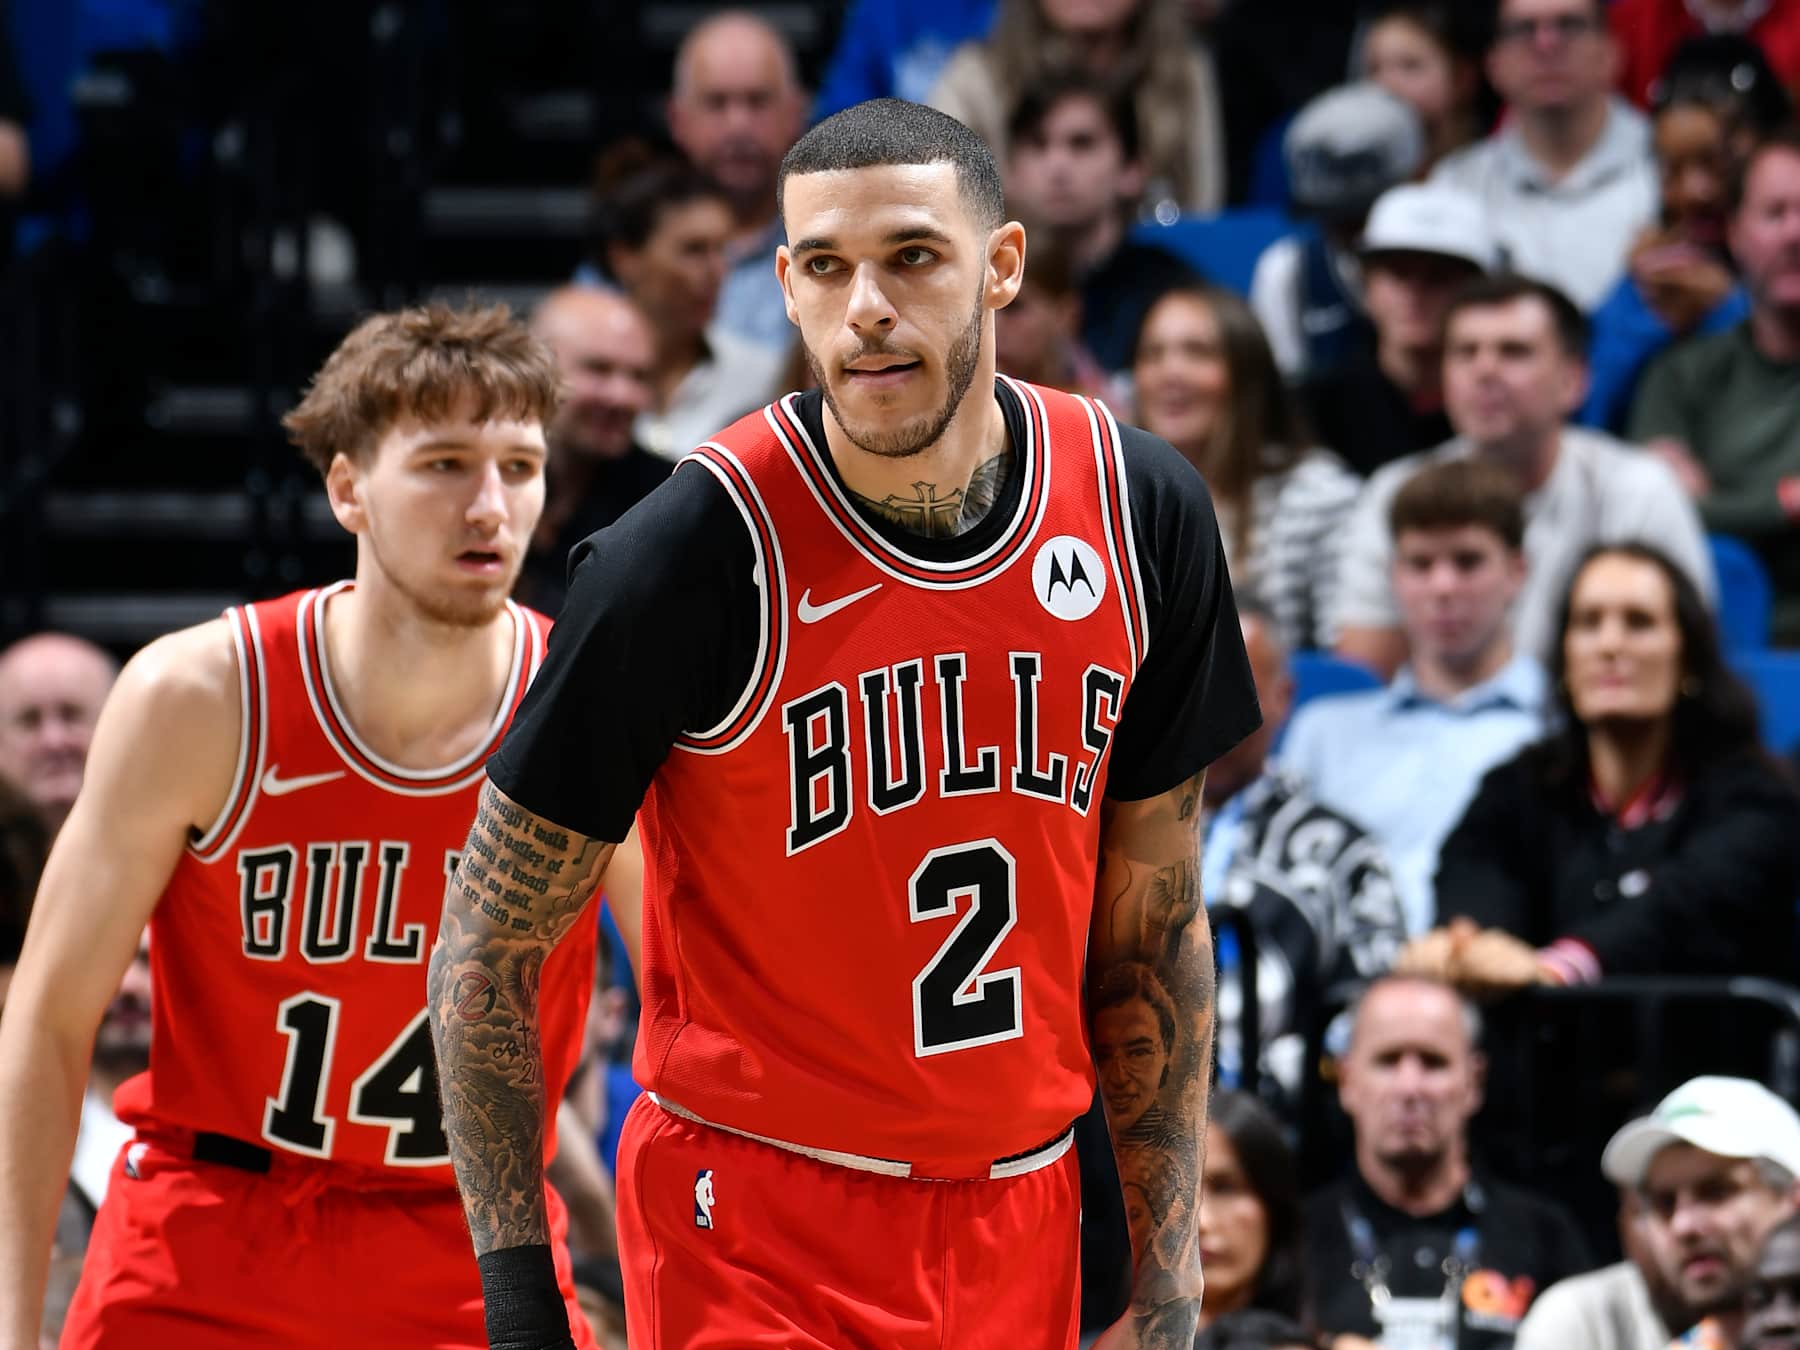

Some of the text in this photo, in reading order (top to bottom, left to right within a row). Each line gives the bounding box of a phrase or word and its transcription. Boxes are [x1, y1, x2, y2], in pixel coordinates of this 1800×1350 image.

[782, 651, 1127, 857] BULLS
[236, 839, 461, 964] BUL
[907, 837, 1024, 1058] 2
[261, 990, 452, 1166] 14
